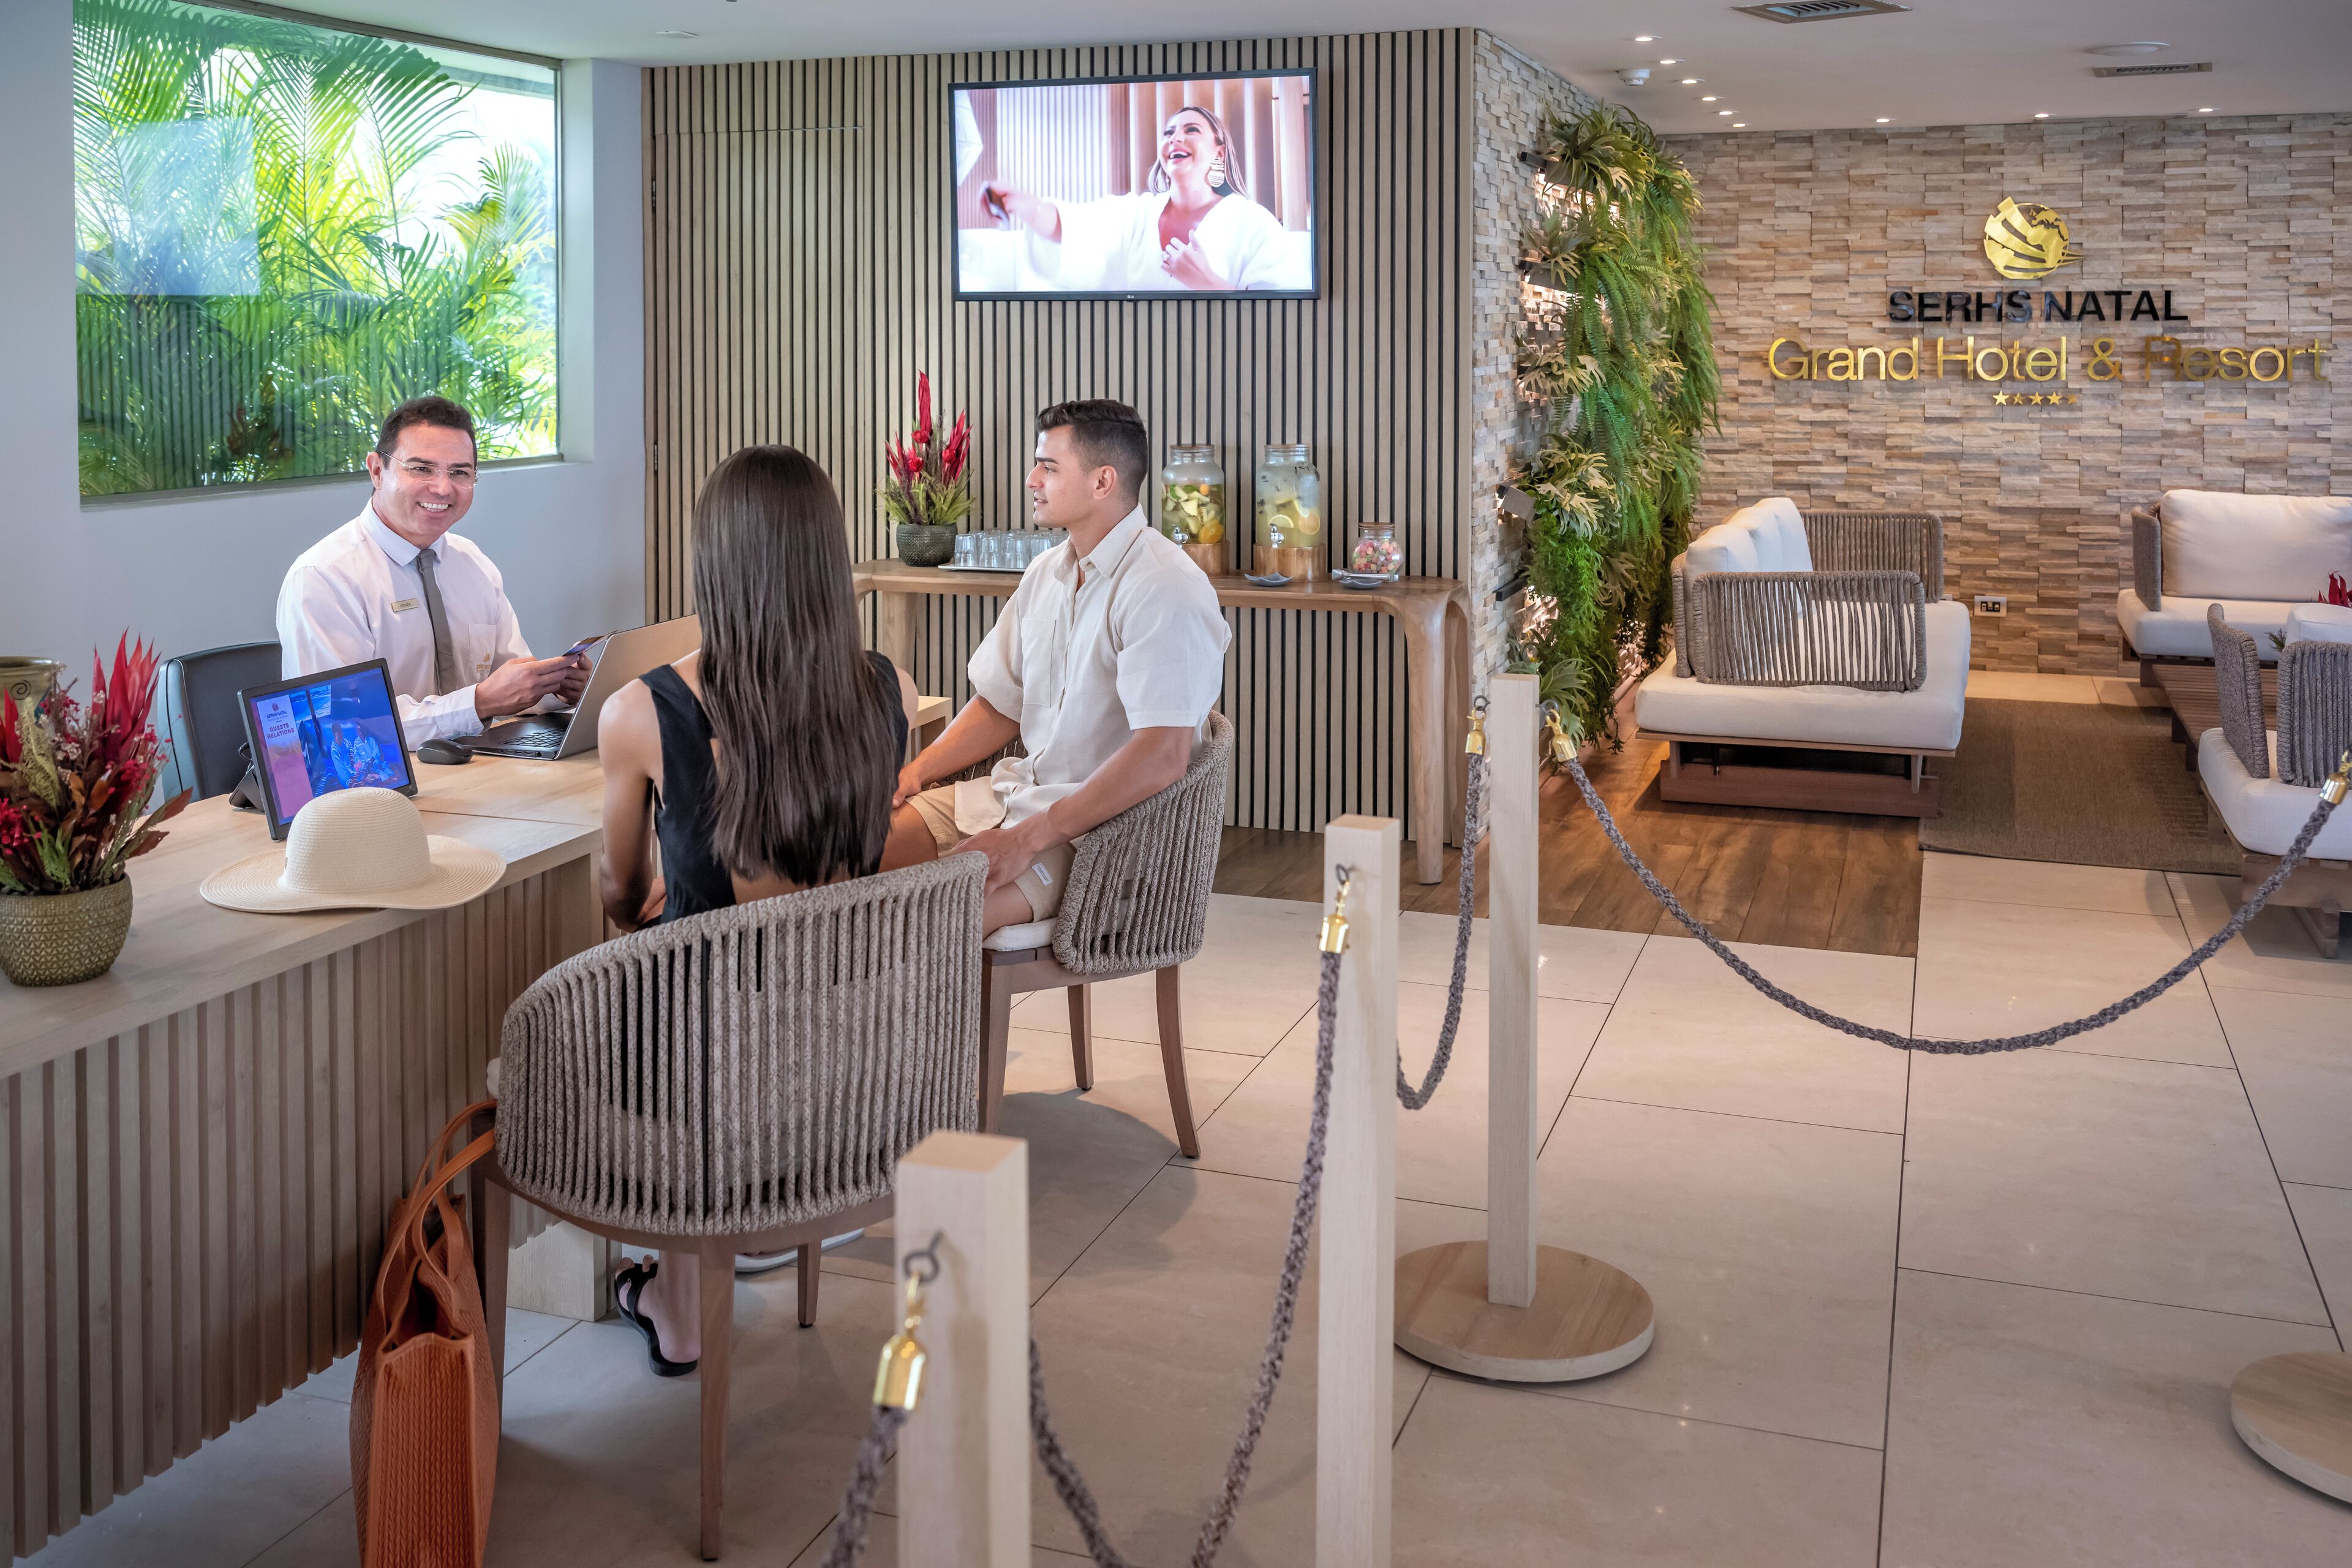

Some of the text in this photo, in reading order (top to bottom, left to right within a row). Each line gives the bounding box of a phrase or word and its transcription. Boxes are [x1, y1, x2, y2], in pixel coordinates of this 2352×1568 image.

[1889, 290, 2188, 323] SERHS NATAL
[1768, 336, 2328, 382] Grand Hotel & Resort
[267, 728, 295, 739] RELATIONS
